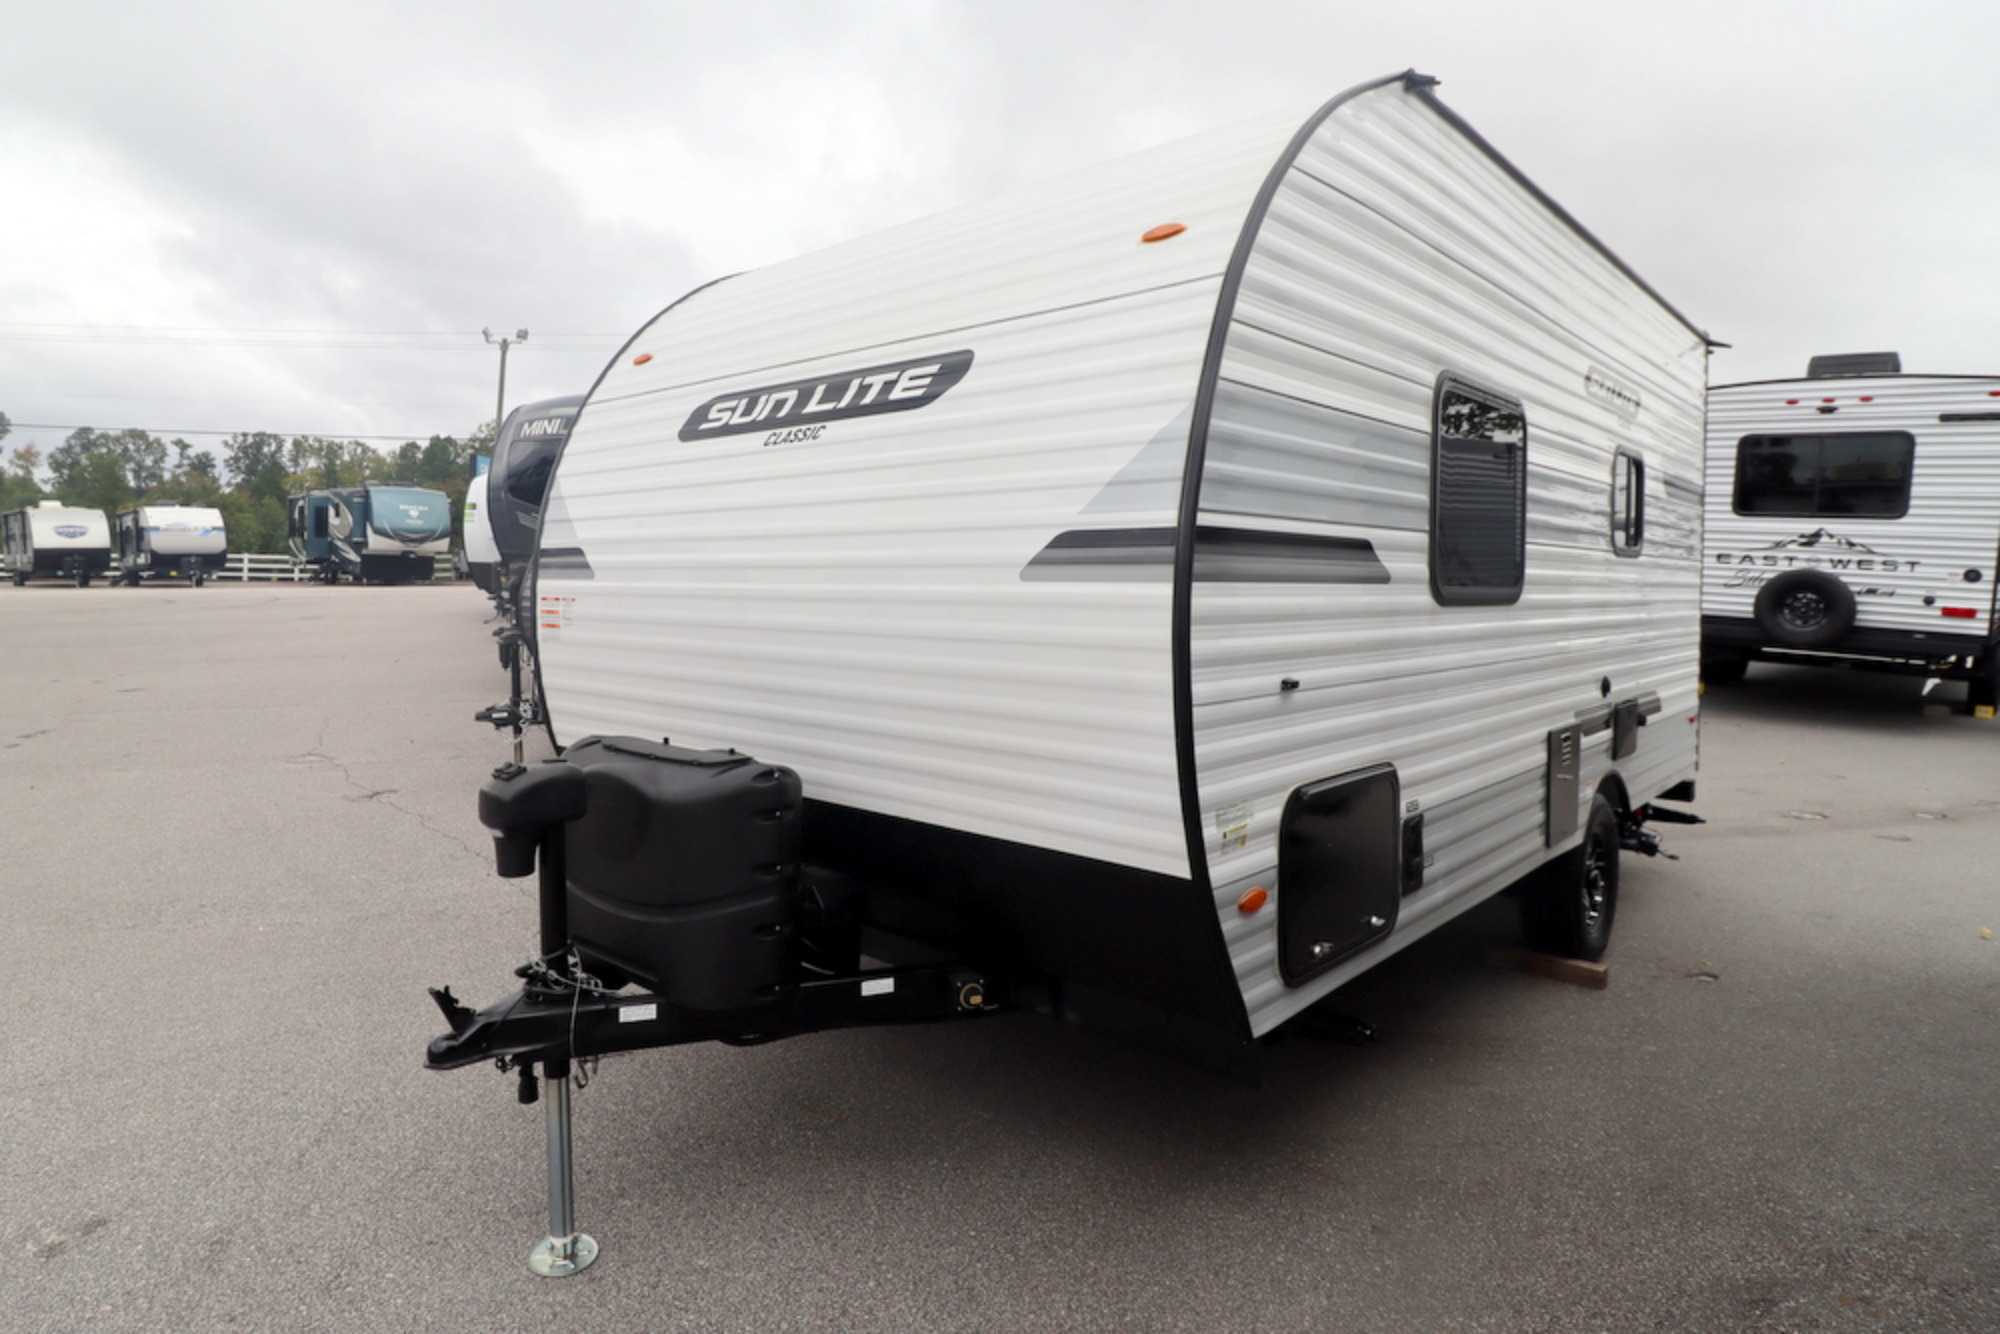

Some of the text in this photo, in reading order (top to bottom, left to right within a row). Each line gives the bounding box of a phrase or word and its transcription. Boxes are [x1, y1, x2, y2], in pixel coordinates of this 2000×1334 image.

[698, 363, 942, 431] SUN LITE
[763, 425, 827, 448] CLASSIC
[1715, 553, 1922, 573] EAST WEST
